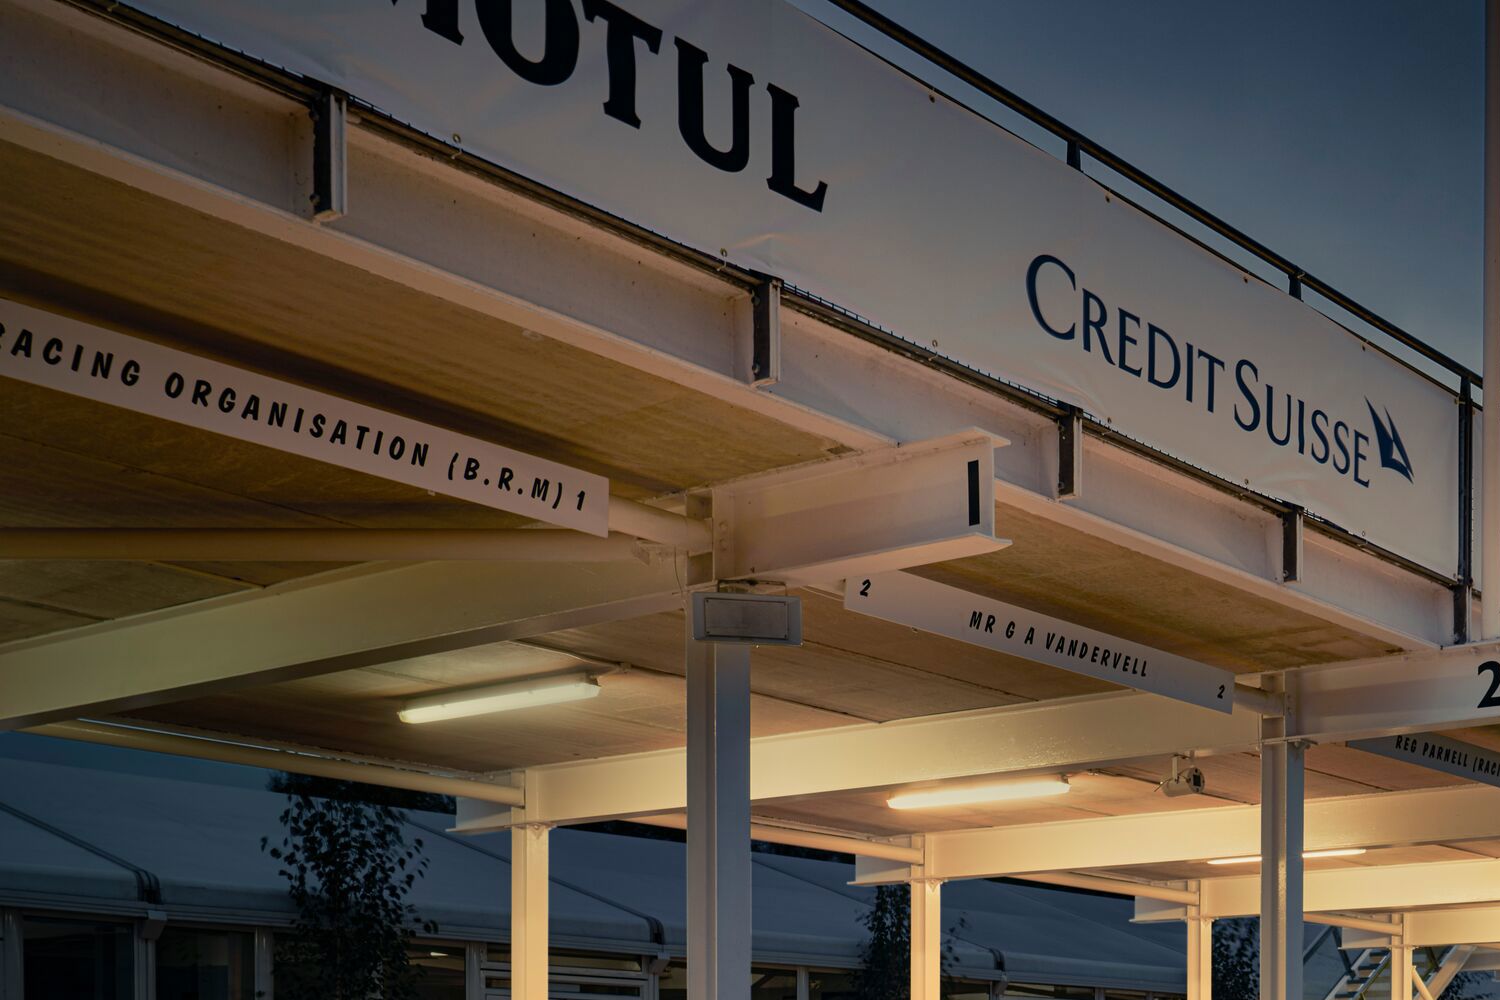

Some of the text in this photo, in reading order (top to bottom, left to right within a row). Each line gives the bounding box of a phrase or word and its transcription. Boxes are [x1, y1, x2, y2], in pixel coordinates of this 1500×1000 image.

[1025, 254, 1371, 488] CREDIT SUISSE
[164, 371, 428, 468] ORGANISATION
[448, 453, 563, 510] (B.R.M)
[576, 489, 586, 512] 1
[859, 578, 1225, 699] 2 MR G A VANDERVELL 2
[1395, 735, 1417, 753] REG
[1422, 741, 1467, 767] PARNELL
